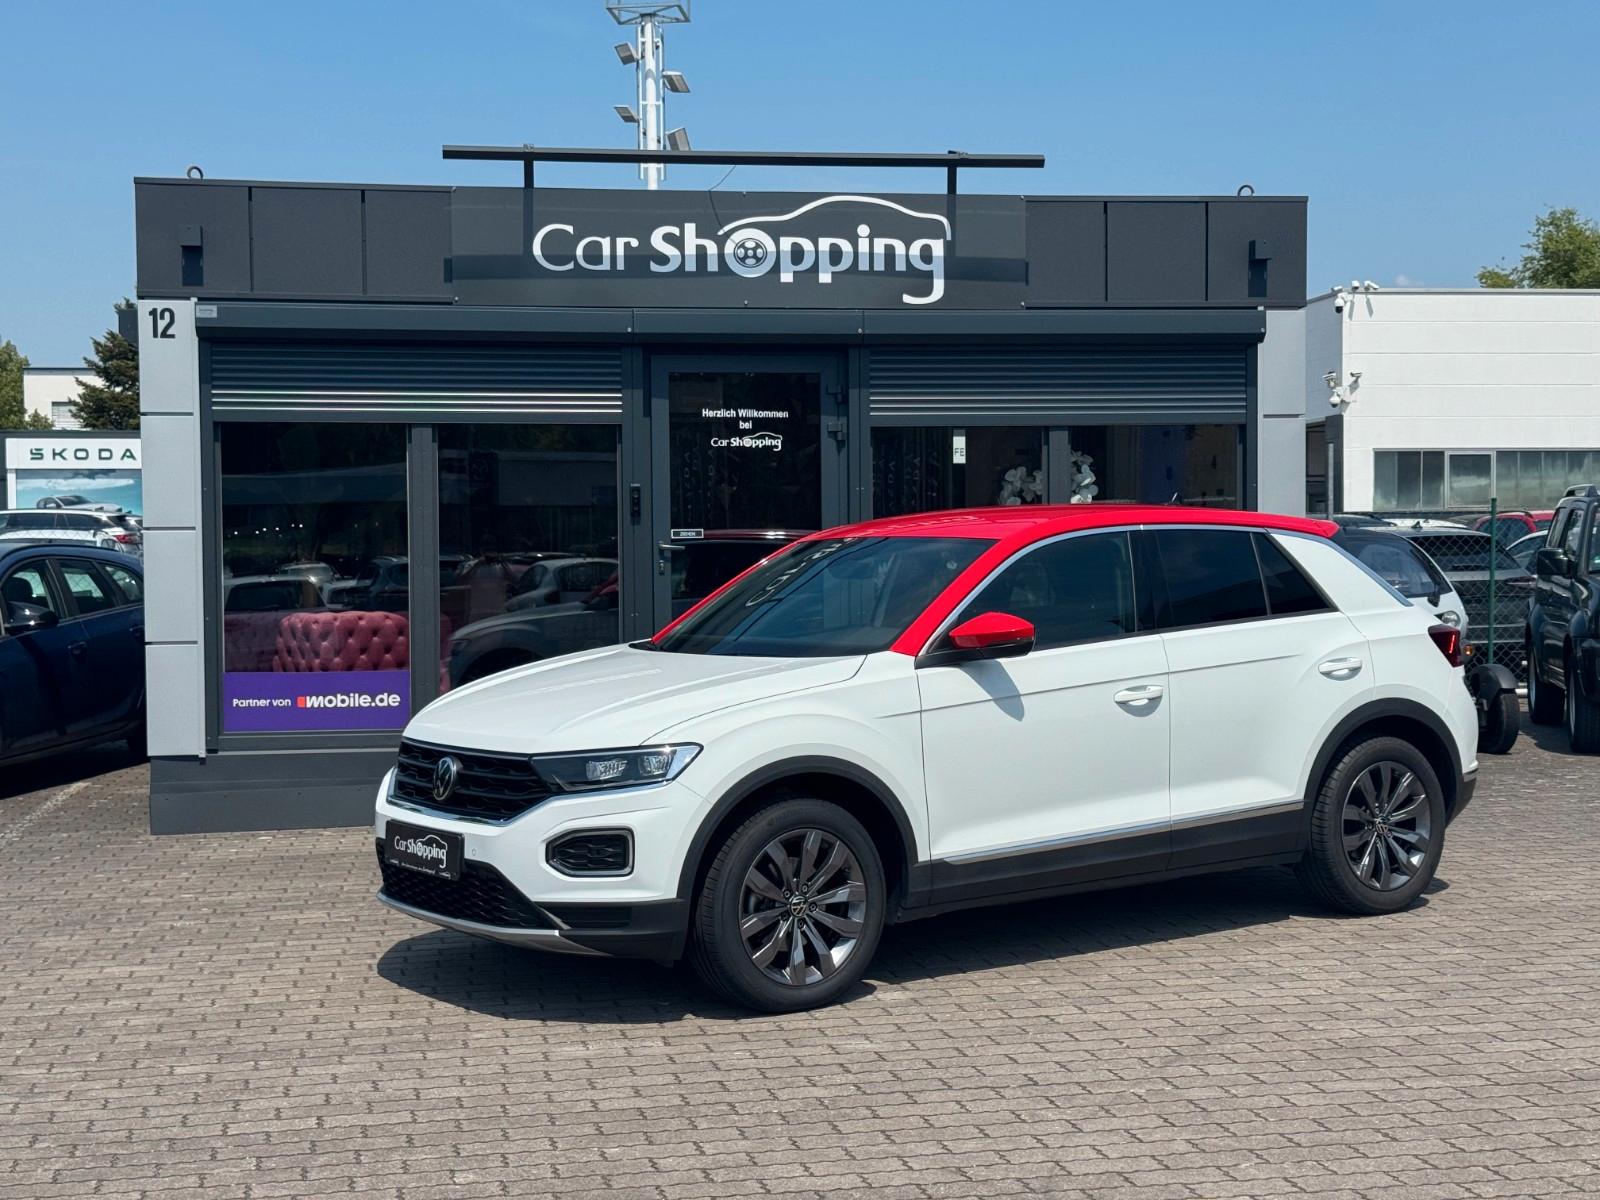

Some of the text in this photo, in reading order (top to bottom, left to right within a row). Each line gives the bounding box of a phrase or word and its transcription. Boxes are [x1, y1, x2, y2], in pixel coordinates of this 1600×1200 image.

[532, 222, 946, 305] Car Shopping
[148, 307, 176, 339] 12
[702, 408, 788, 418] Herzlich Willkommen
[739, 420, 753, 429] bei
[711, 436, 782, 451] Car Shopping
[232, 693, 401, 708] Partner von mobile.de
[394, 835, 448, 869] Car Shopping
